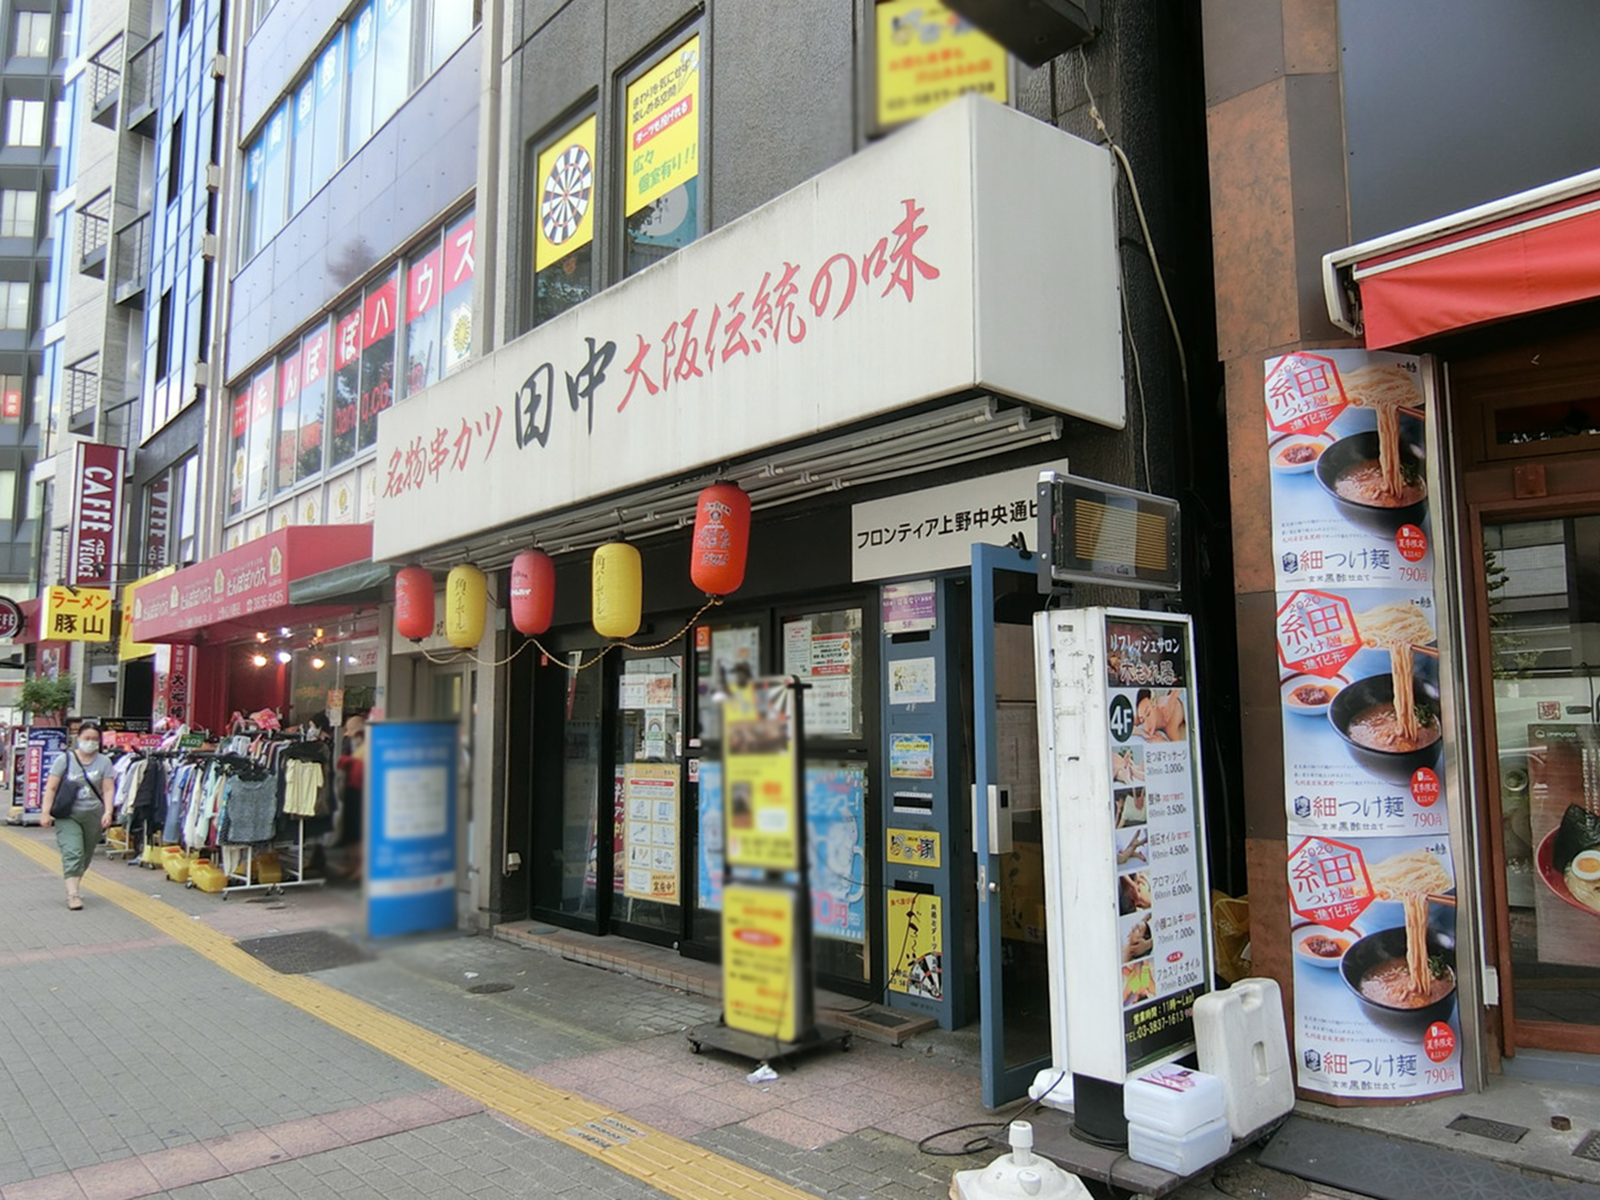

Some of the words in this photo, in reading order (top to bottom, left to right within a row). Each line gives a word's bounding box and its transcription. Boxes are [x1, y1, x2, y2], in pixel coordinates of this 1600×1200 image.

[633, 149, 655, 175] 広々
[1277, 358, 1309, 377] 2020
[1290, 410, 1334, 431] 進化形
[1300, 548, 1391, 571] 細つけ麺
[52, 591, 110, 611] ラーメン
[1289, 596, 1322, 614] 2020
[54, 614, 104, 634] 豚山
[1110, 634, 1180, 654] リフレッシュサロン
[1302, 649, 1348, 671] 進化形
[1111, 706, 1132, 736] 4F
[1313, 796, 1405, 818] 細つけ麺
[1300, 844, 1334, 860] 2020
[908, 870, 919, 879] 2F
[1313, 901, 1361, 921] 進化形
[1323, 1051, 1417, 1077] 細つけ麺
